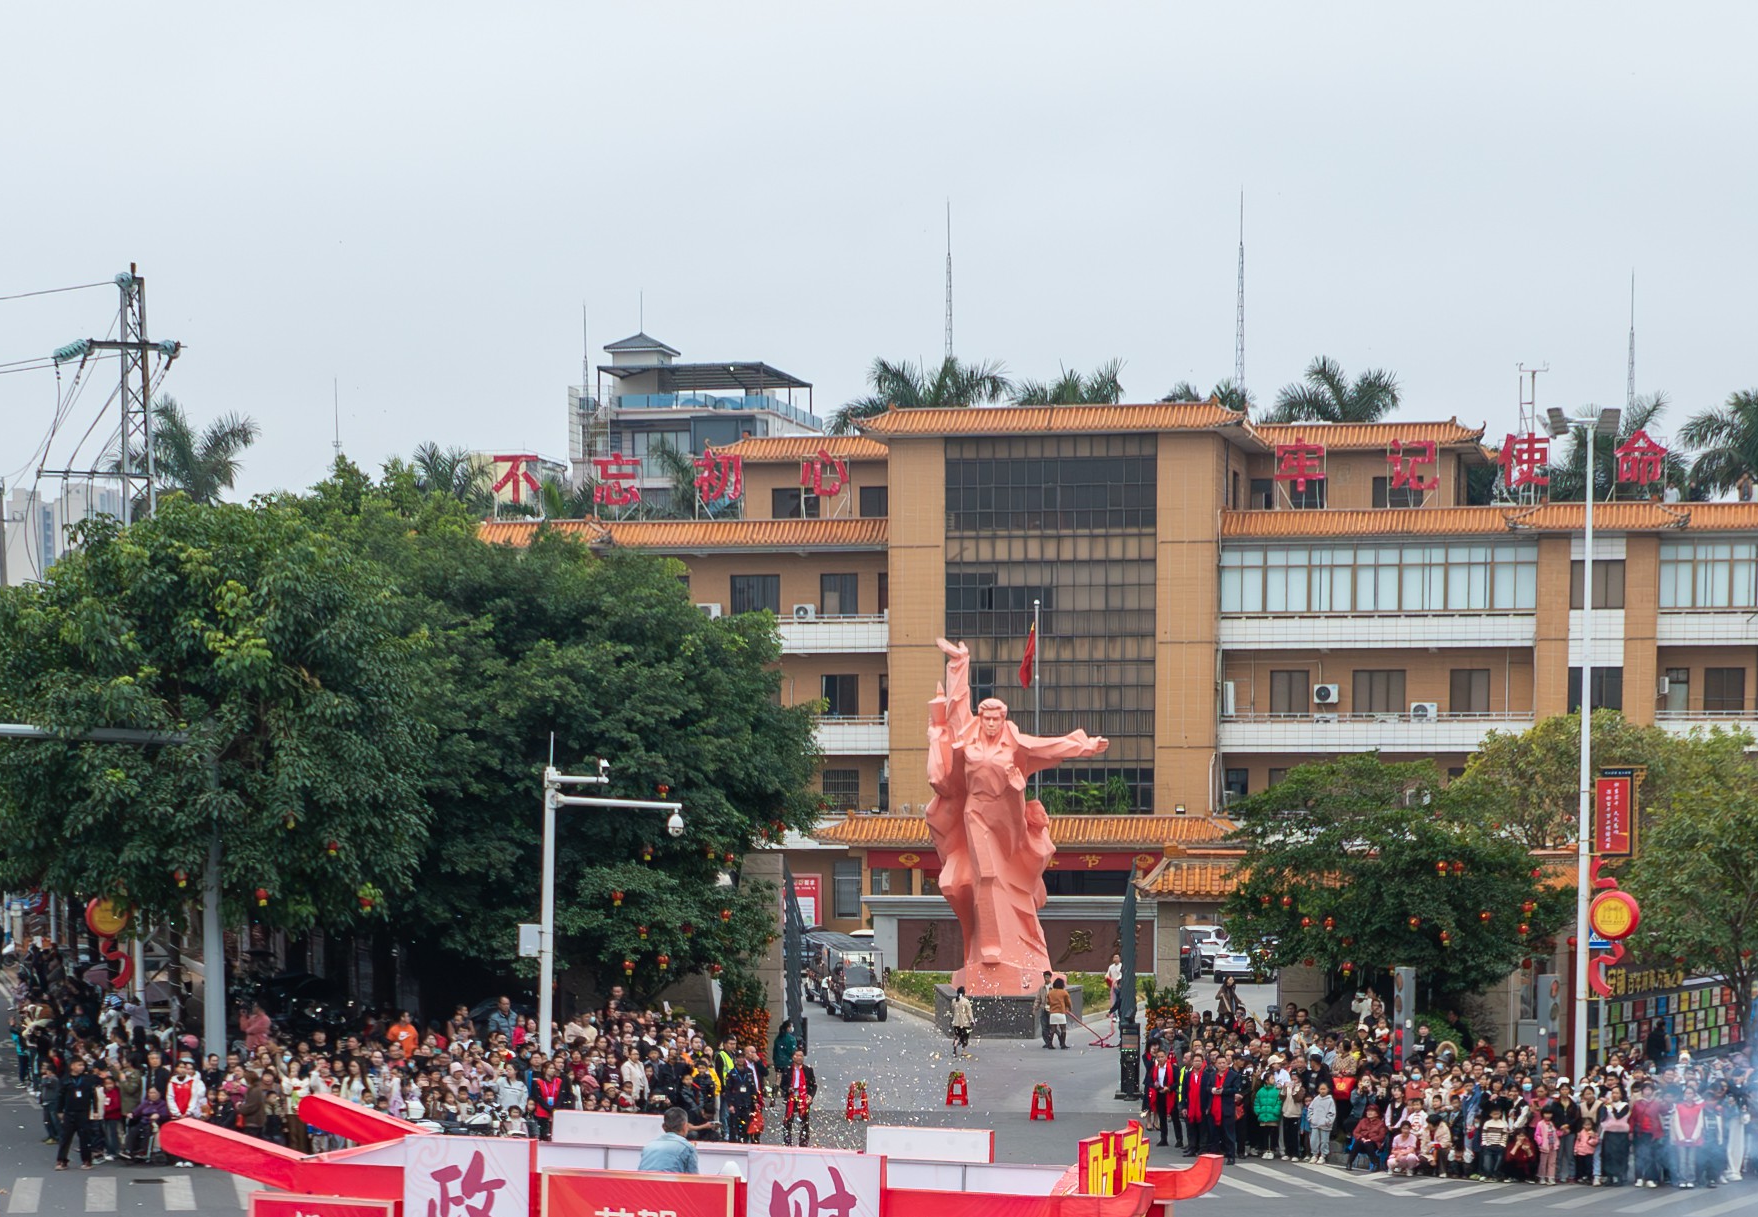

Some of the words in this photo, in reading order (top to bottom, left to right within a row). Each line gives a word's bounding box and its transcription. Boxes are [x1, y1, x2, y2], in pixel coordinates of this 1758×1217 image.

[493, 450, 848, 503] 不忘初心
[1274, 430, 1668, 492] 牢记使命
